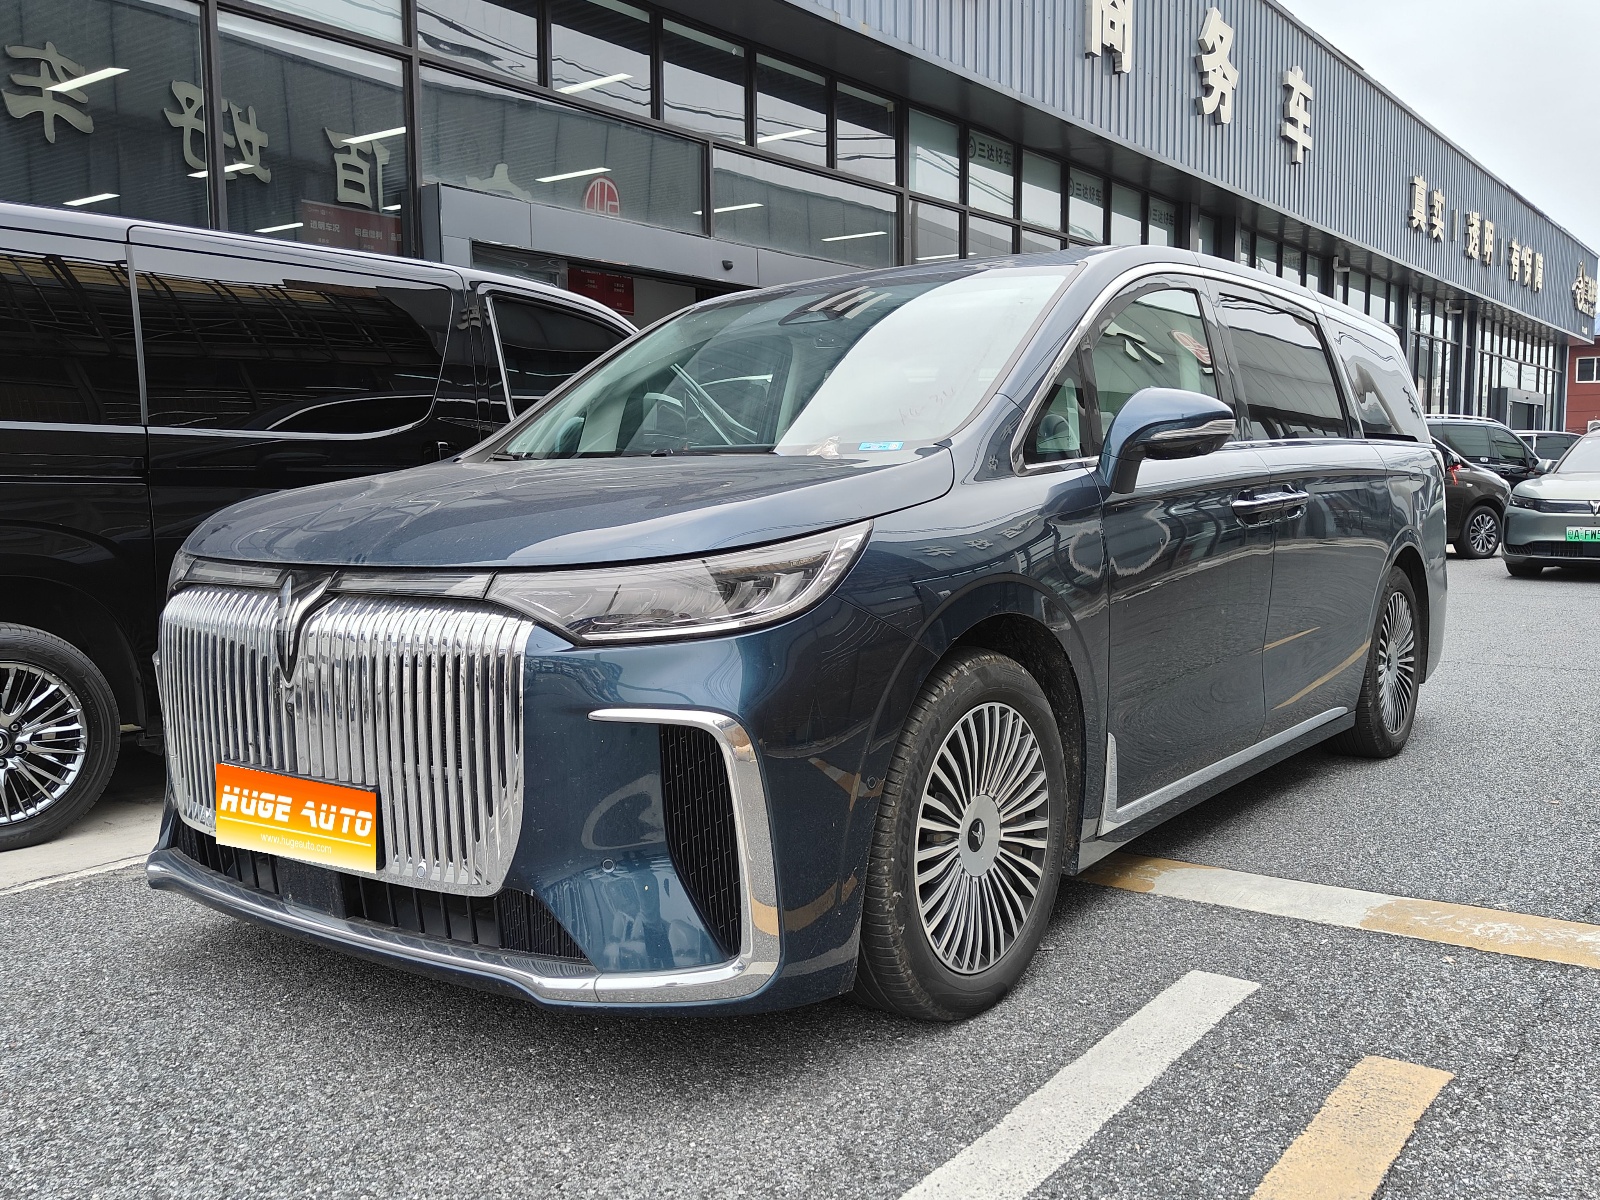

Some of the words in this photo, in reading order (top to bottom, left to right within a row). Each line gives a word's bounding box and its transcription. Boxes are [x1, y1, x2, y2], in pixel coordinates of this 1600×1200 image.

[977, 142, 1012, 168] 三达好车
[1075, 181, 1102, 203] 三达好车
[1408, 175, 1445, 242] 真实
